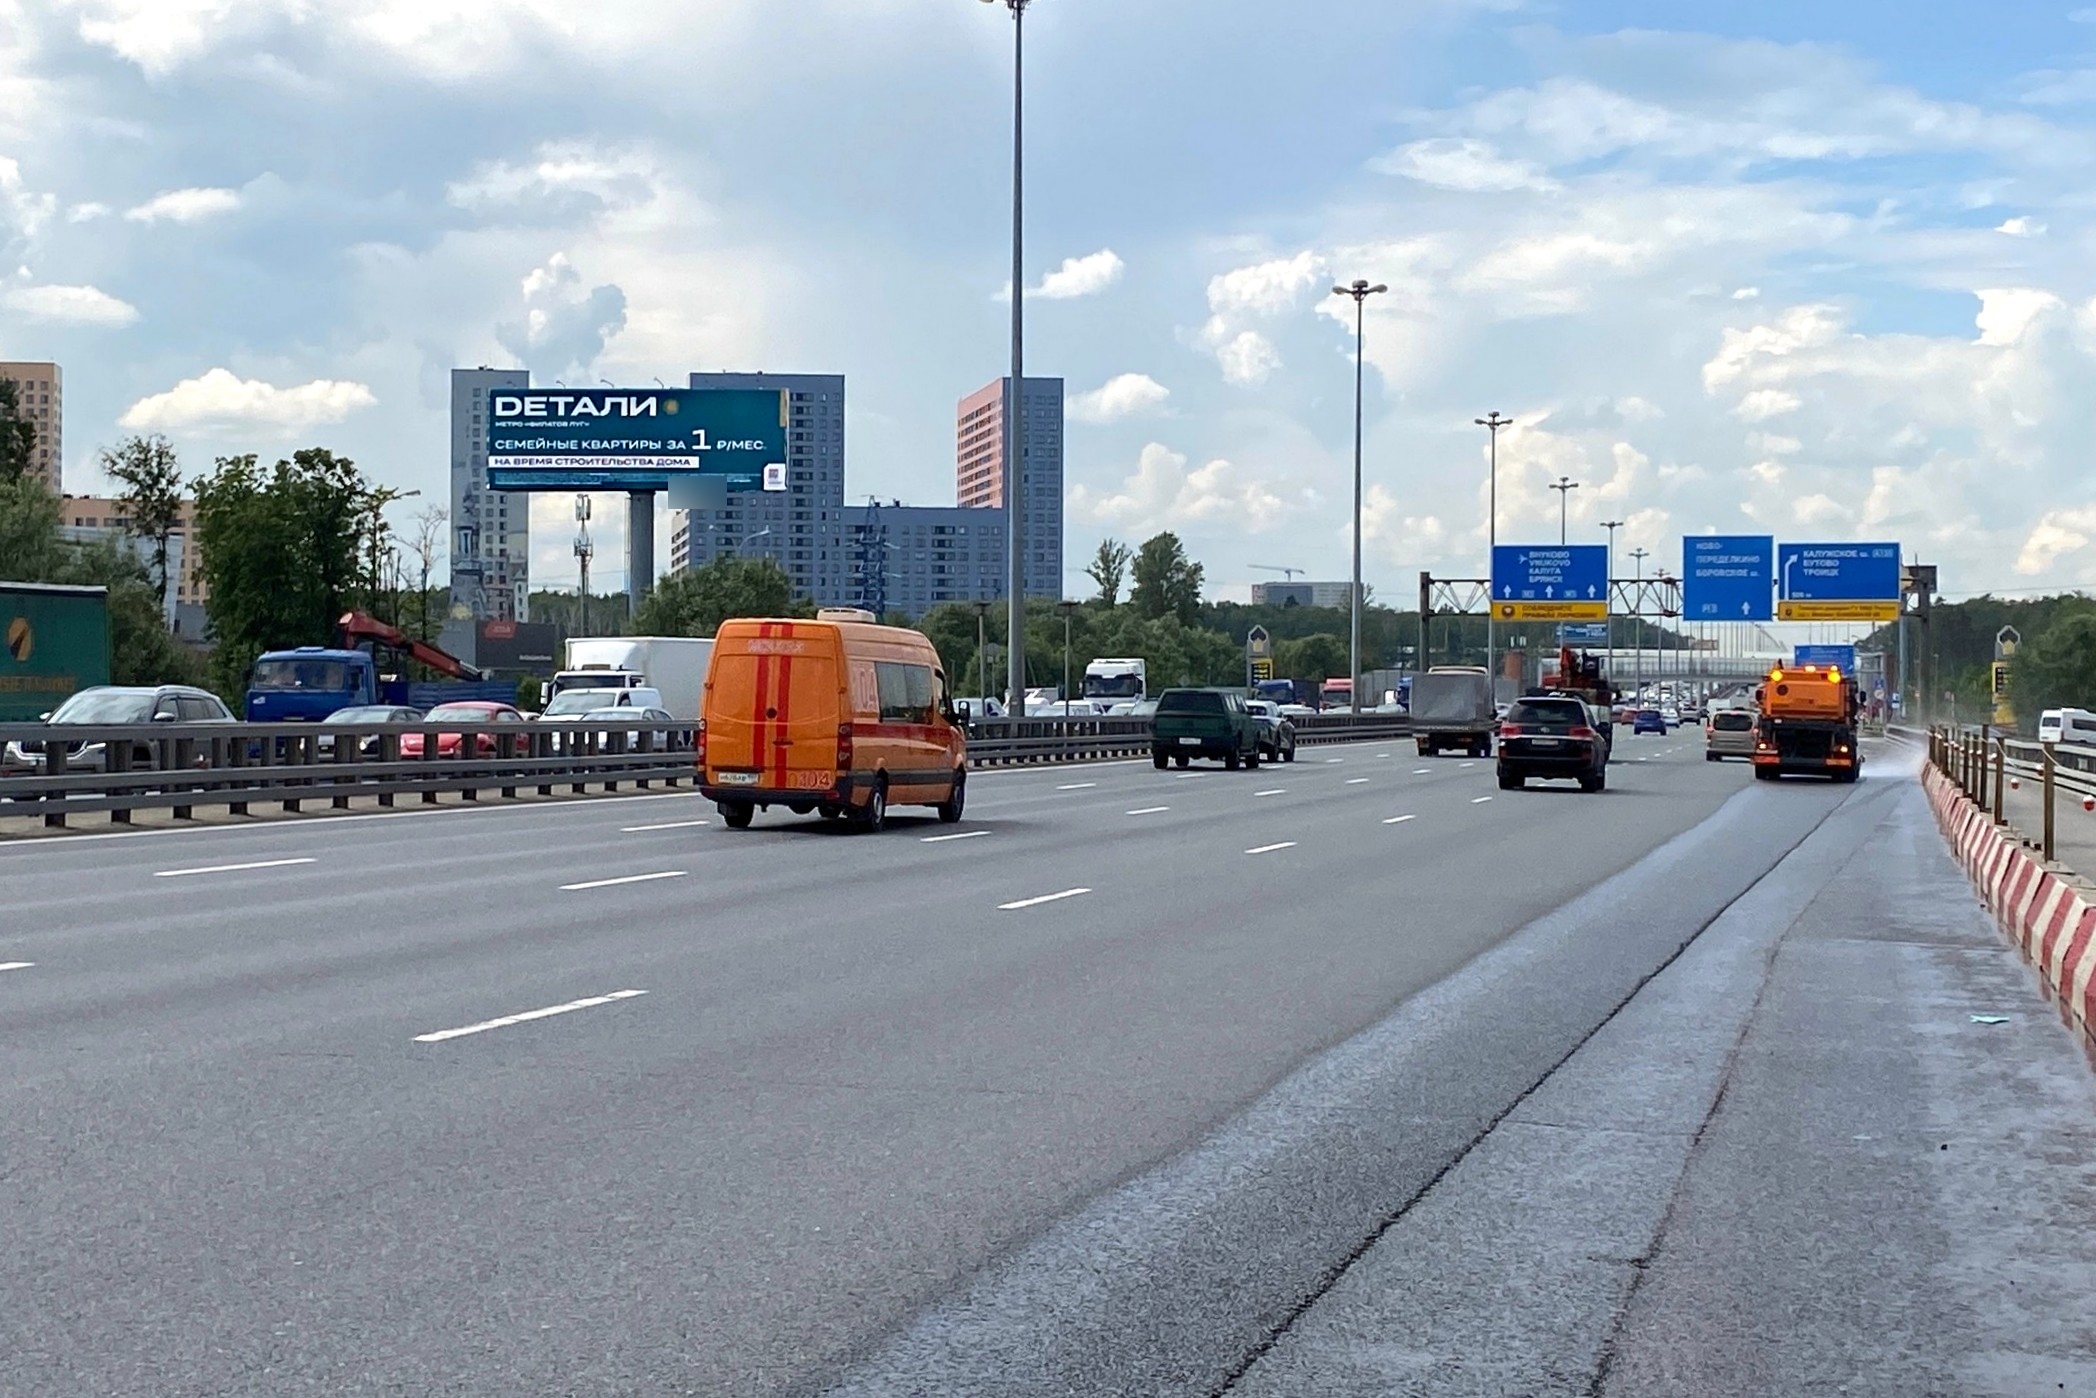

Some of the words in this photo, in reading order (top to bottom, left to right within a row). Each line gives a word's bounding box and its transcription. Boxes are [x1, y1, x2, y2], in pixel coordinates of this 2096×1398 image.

[495, 438, 579, 450] СЕМЕЙНЫЕ
[581, 439, 662, 450] КВАРТИРЫ
[666, 439, 687, 450] ЗА
[691, 429, 712, 450] 1
[494, 458, 511, 466] НА
[513, 458, 553, 466] ВРЕМЯ
[554, 458, 655, 466] СТРОИТЕЛЬСТВА
[656, 458, 691, 467] ДОМА
[1529, 551, 1570, 559] ВНУКОВО
[1803, 550, 1857, 558] КАЛУЖСКОЕ
[1696, 555, 1760, 564] ПЕРЕДЕЛКИНО
[1803, 559, 1840, 567] БУТОВО
[1529, 567, 1562, 575] КАЛУГА
[1803, 568, 1840, 576] ТРОИЦК
[1529, 575, 1563, 583] БРЯНСК
